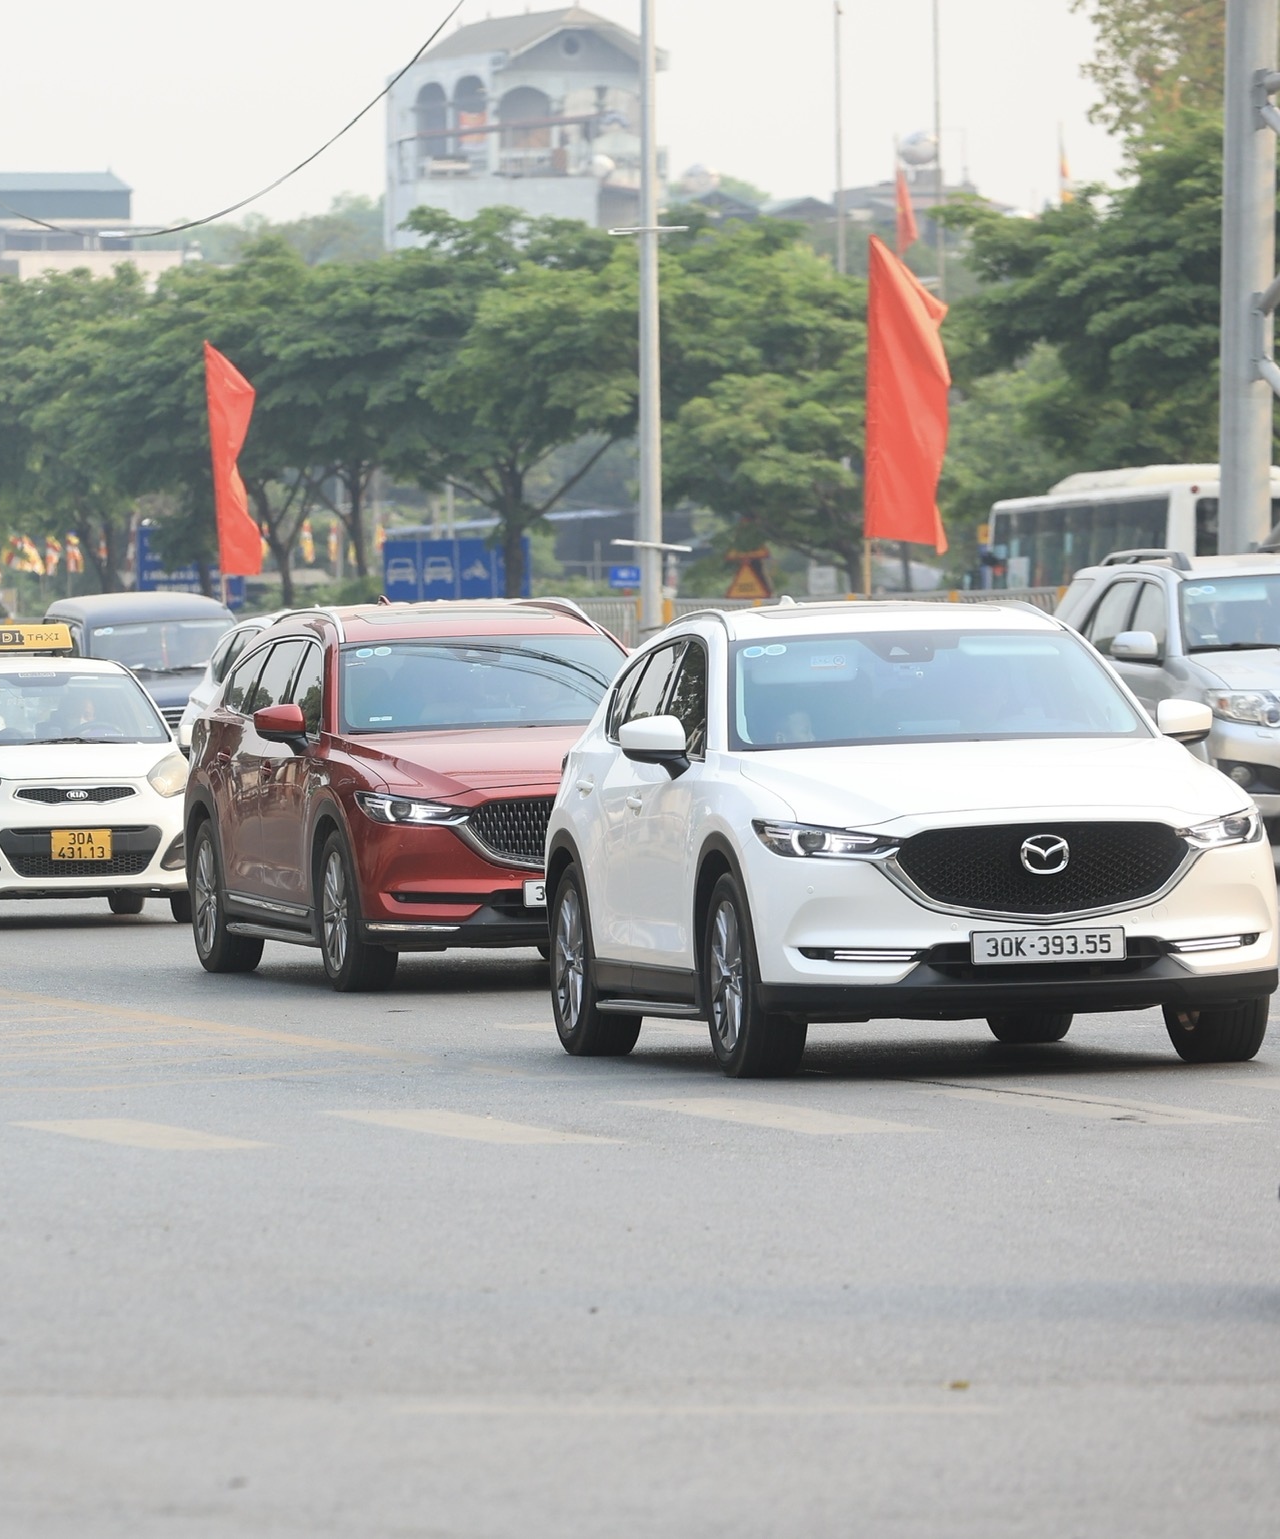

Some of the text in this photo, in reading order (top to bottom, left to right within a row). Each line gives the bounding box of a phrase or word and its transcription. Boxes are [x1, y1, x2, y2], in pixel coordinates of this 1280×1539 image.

[27, 632, 60, 641] TAXI
[68, 832, 94, 845] 30A
[58, 846, 105, 859] 431.13
[986, 934, 1111, 957] 30K-393.55
